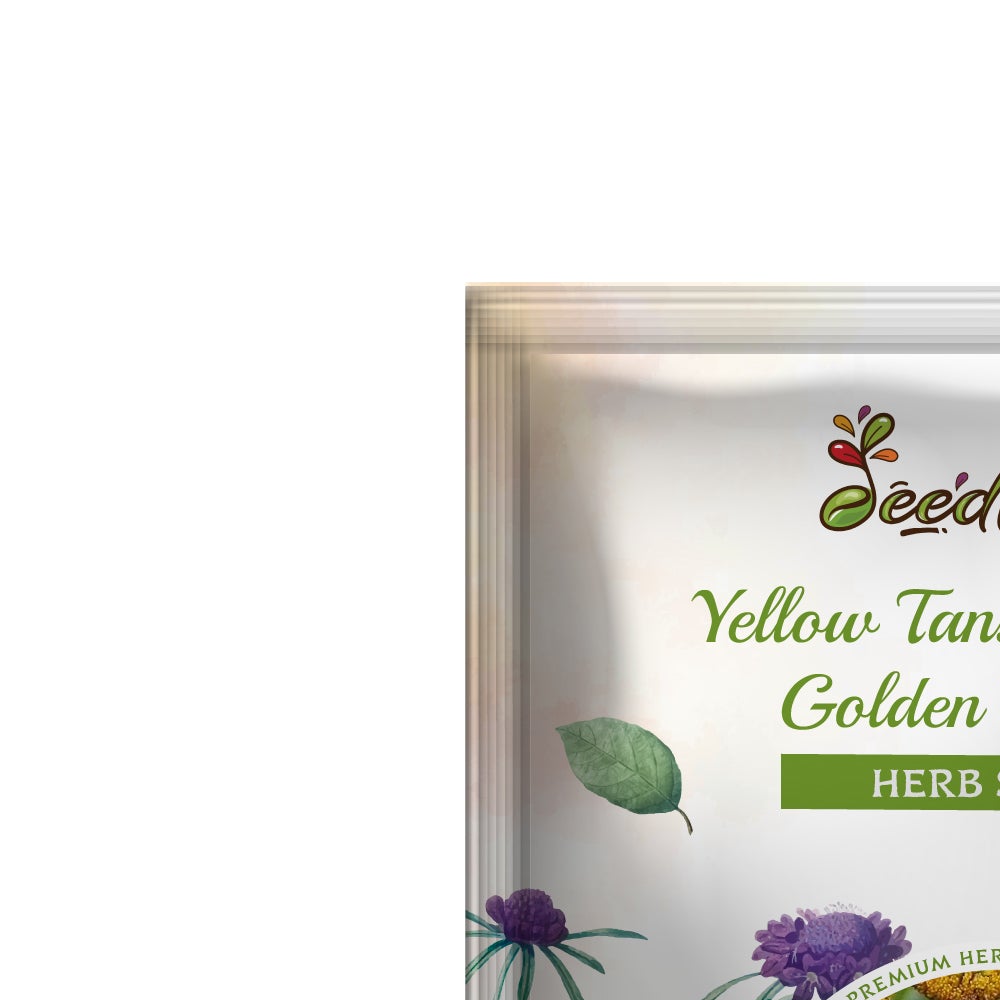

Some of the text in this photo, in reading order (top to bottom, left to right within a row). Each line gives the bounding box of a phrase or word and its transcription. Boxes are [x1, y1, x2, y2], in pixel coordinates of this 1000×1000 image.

[692, 585, 881, 644] Yellow
[781, 671, 987, 731] Golden
[872, 768, 983, 799] HERB
